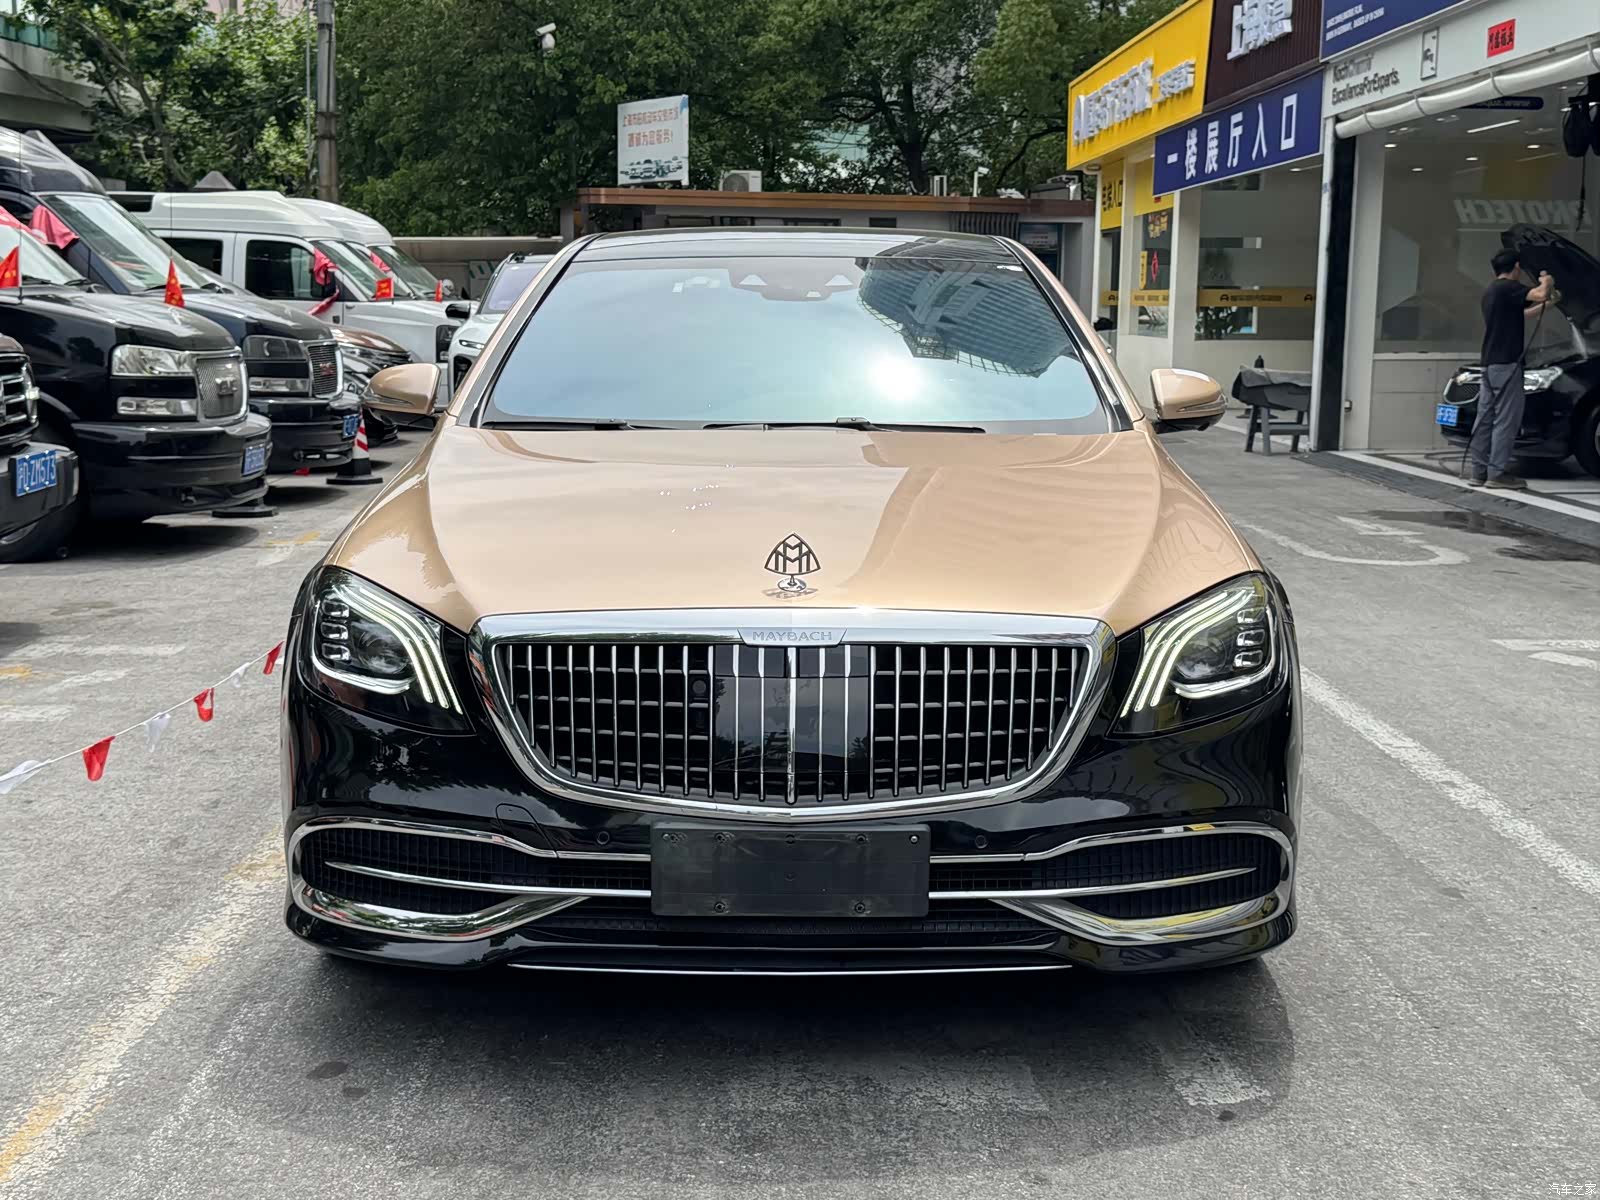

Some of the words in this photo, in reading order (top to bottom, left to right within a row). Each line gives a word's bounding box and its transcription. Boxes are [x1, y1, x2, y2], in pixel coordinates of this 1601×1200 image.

[1166, 93, 1298, 181] 一楼展厅入口
[752, 630, 832, 641] MAYBACH
